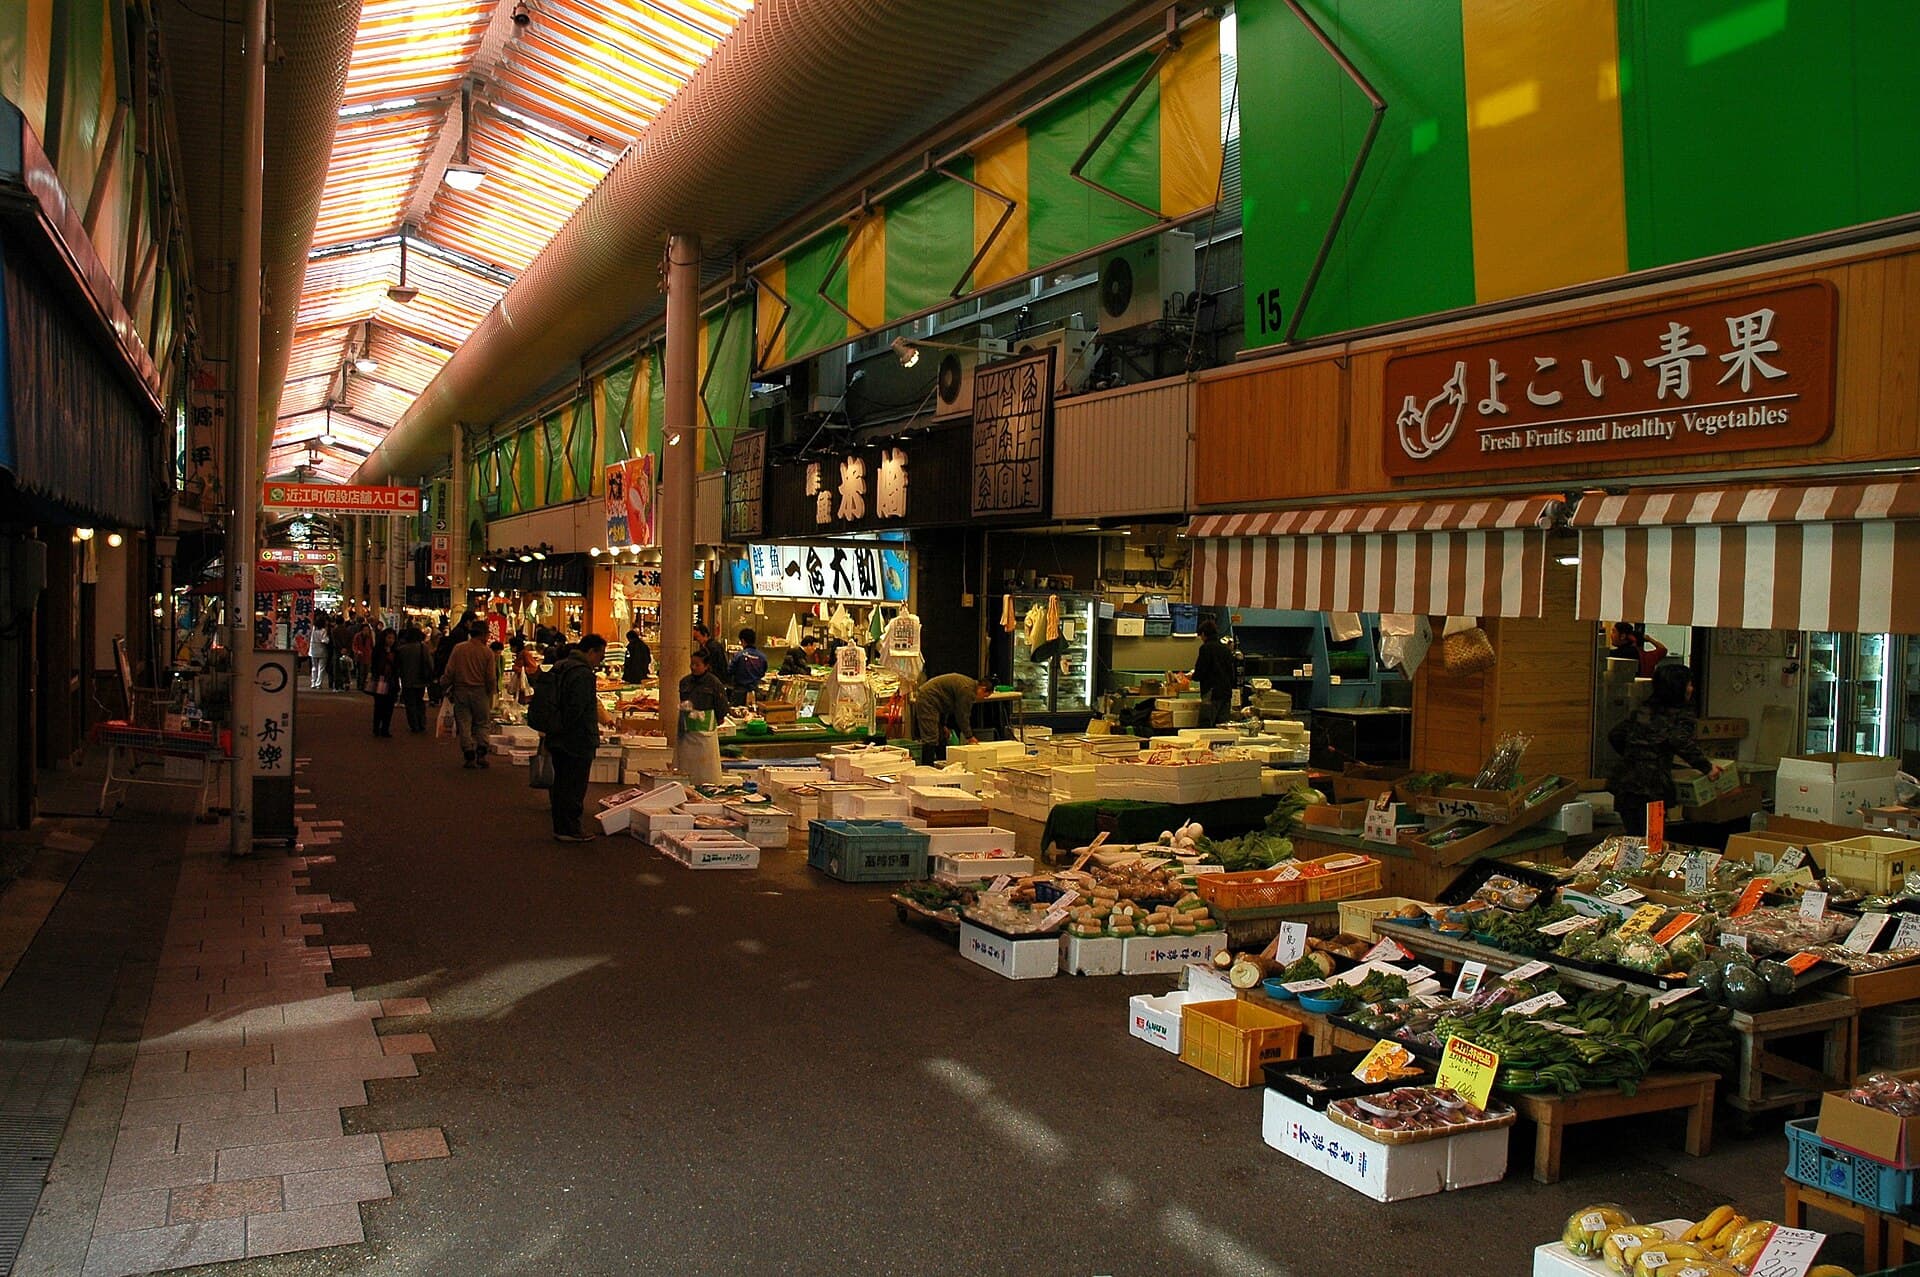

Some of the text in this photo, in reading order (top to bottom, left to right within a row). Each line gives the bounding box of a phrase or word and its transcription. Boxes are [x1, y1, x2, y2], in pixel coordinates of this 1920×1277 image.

[1257, 288, 1282, 335] 15
[1476, 307, 1789, 416] よこい青果
[1480, 406, 1788, 452] Fresh Fruits and healthy Vegetables
[286, 488, 396, 506] 近江町仮設店舗入口
[1299, 1124, 1354, 1165] 万能ねぎ
